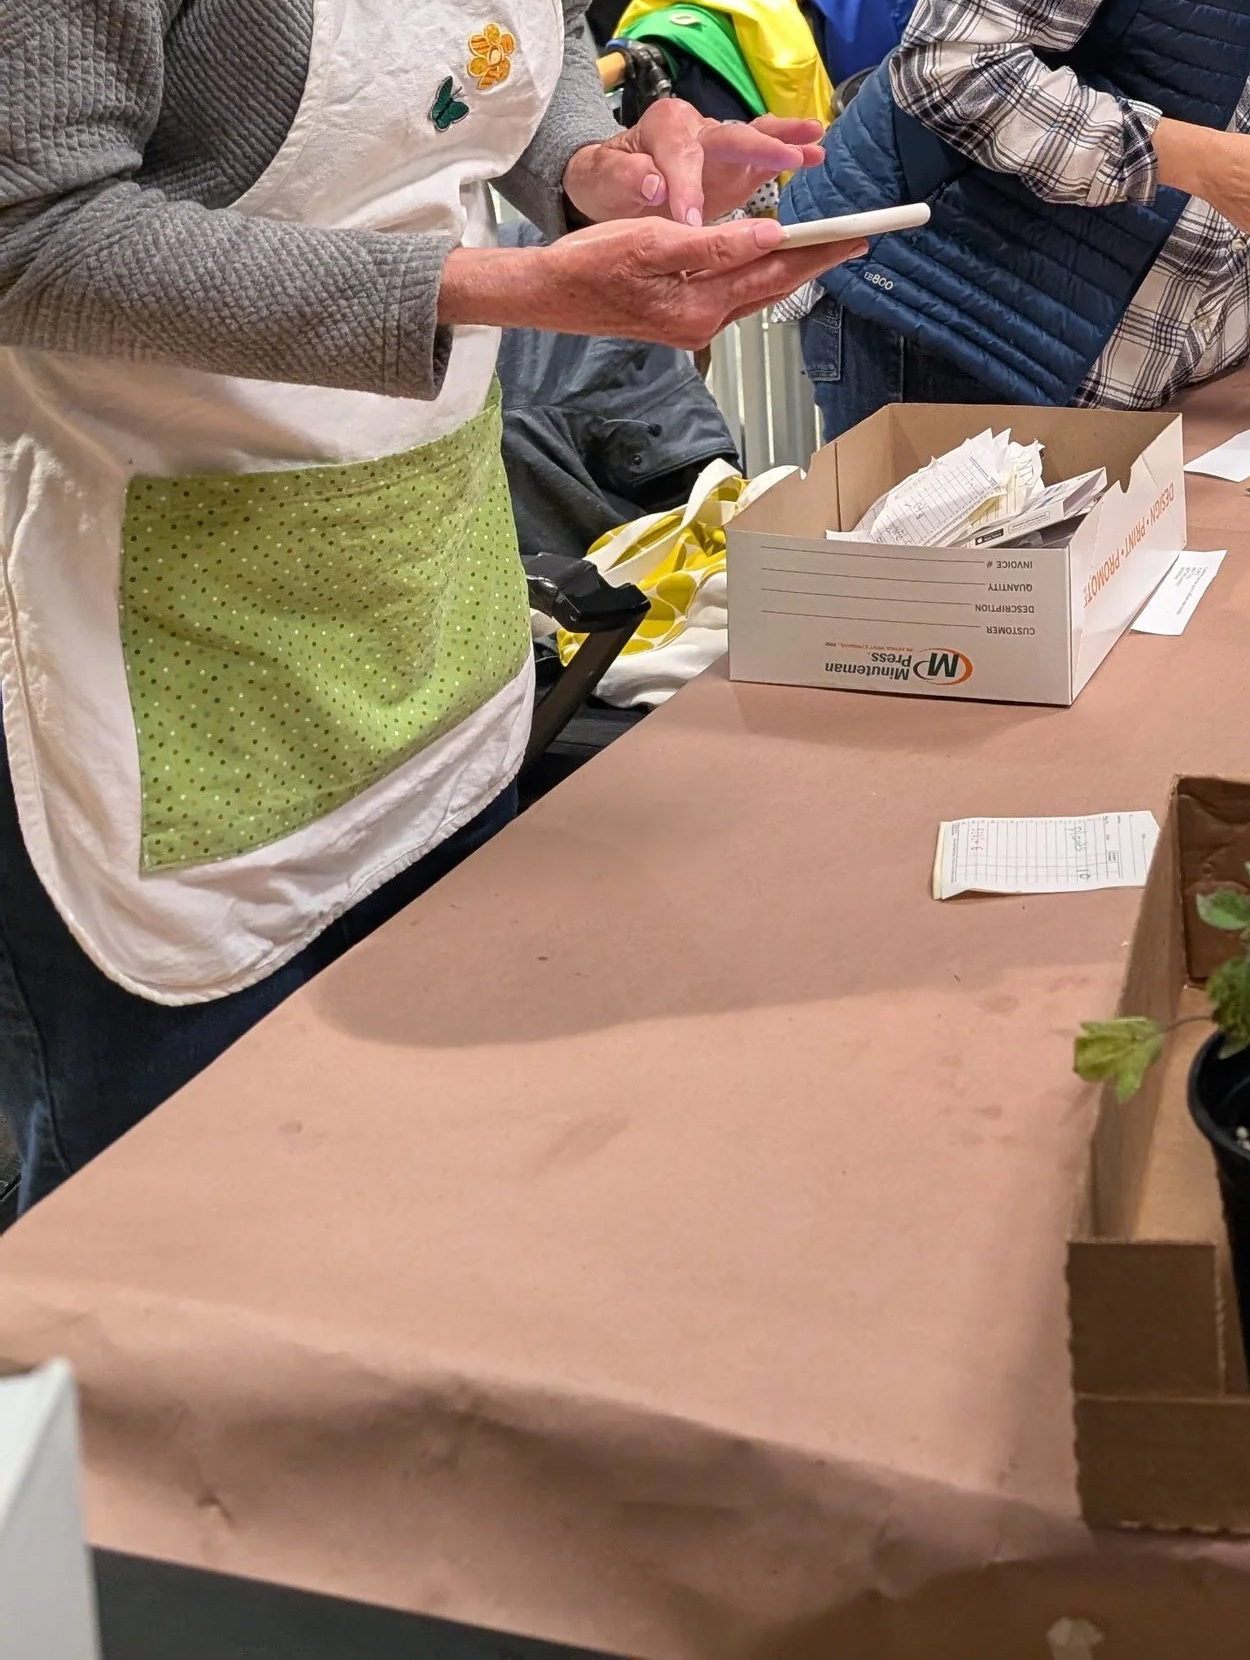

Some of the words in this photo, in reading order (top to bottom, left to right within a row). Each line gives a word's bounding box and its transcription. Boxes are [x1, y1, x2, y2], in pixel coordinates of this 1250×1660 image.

[864, 271, 894, 291] EB800
[1150, 482, 1175, 526] DESIGN
[1125, 517, 1146, 558] PRINT
[996, 560, 1033, 569] INVOICE
[987, 582, 1033, 592] QUANTITY
[1083, 548, 1121, 608] PROMOTE
[975, 604, 1035, 613] DESCRIPTION
[986, 625, 1036, 635] CUSTOMER
[825, 662, 910, 681] Minuteman
